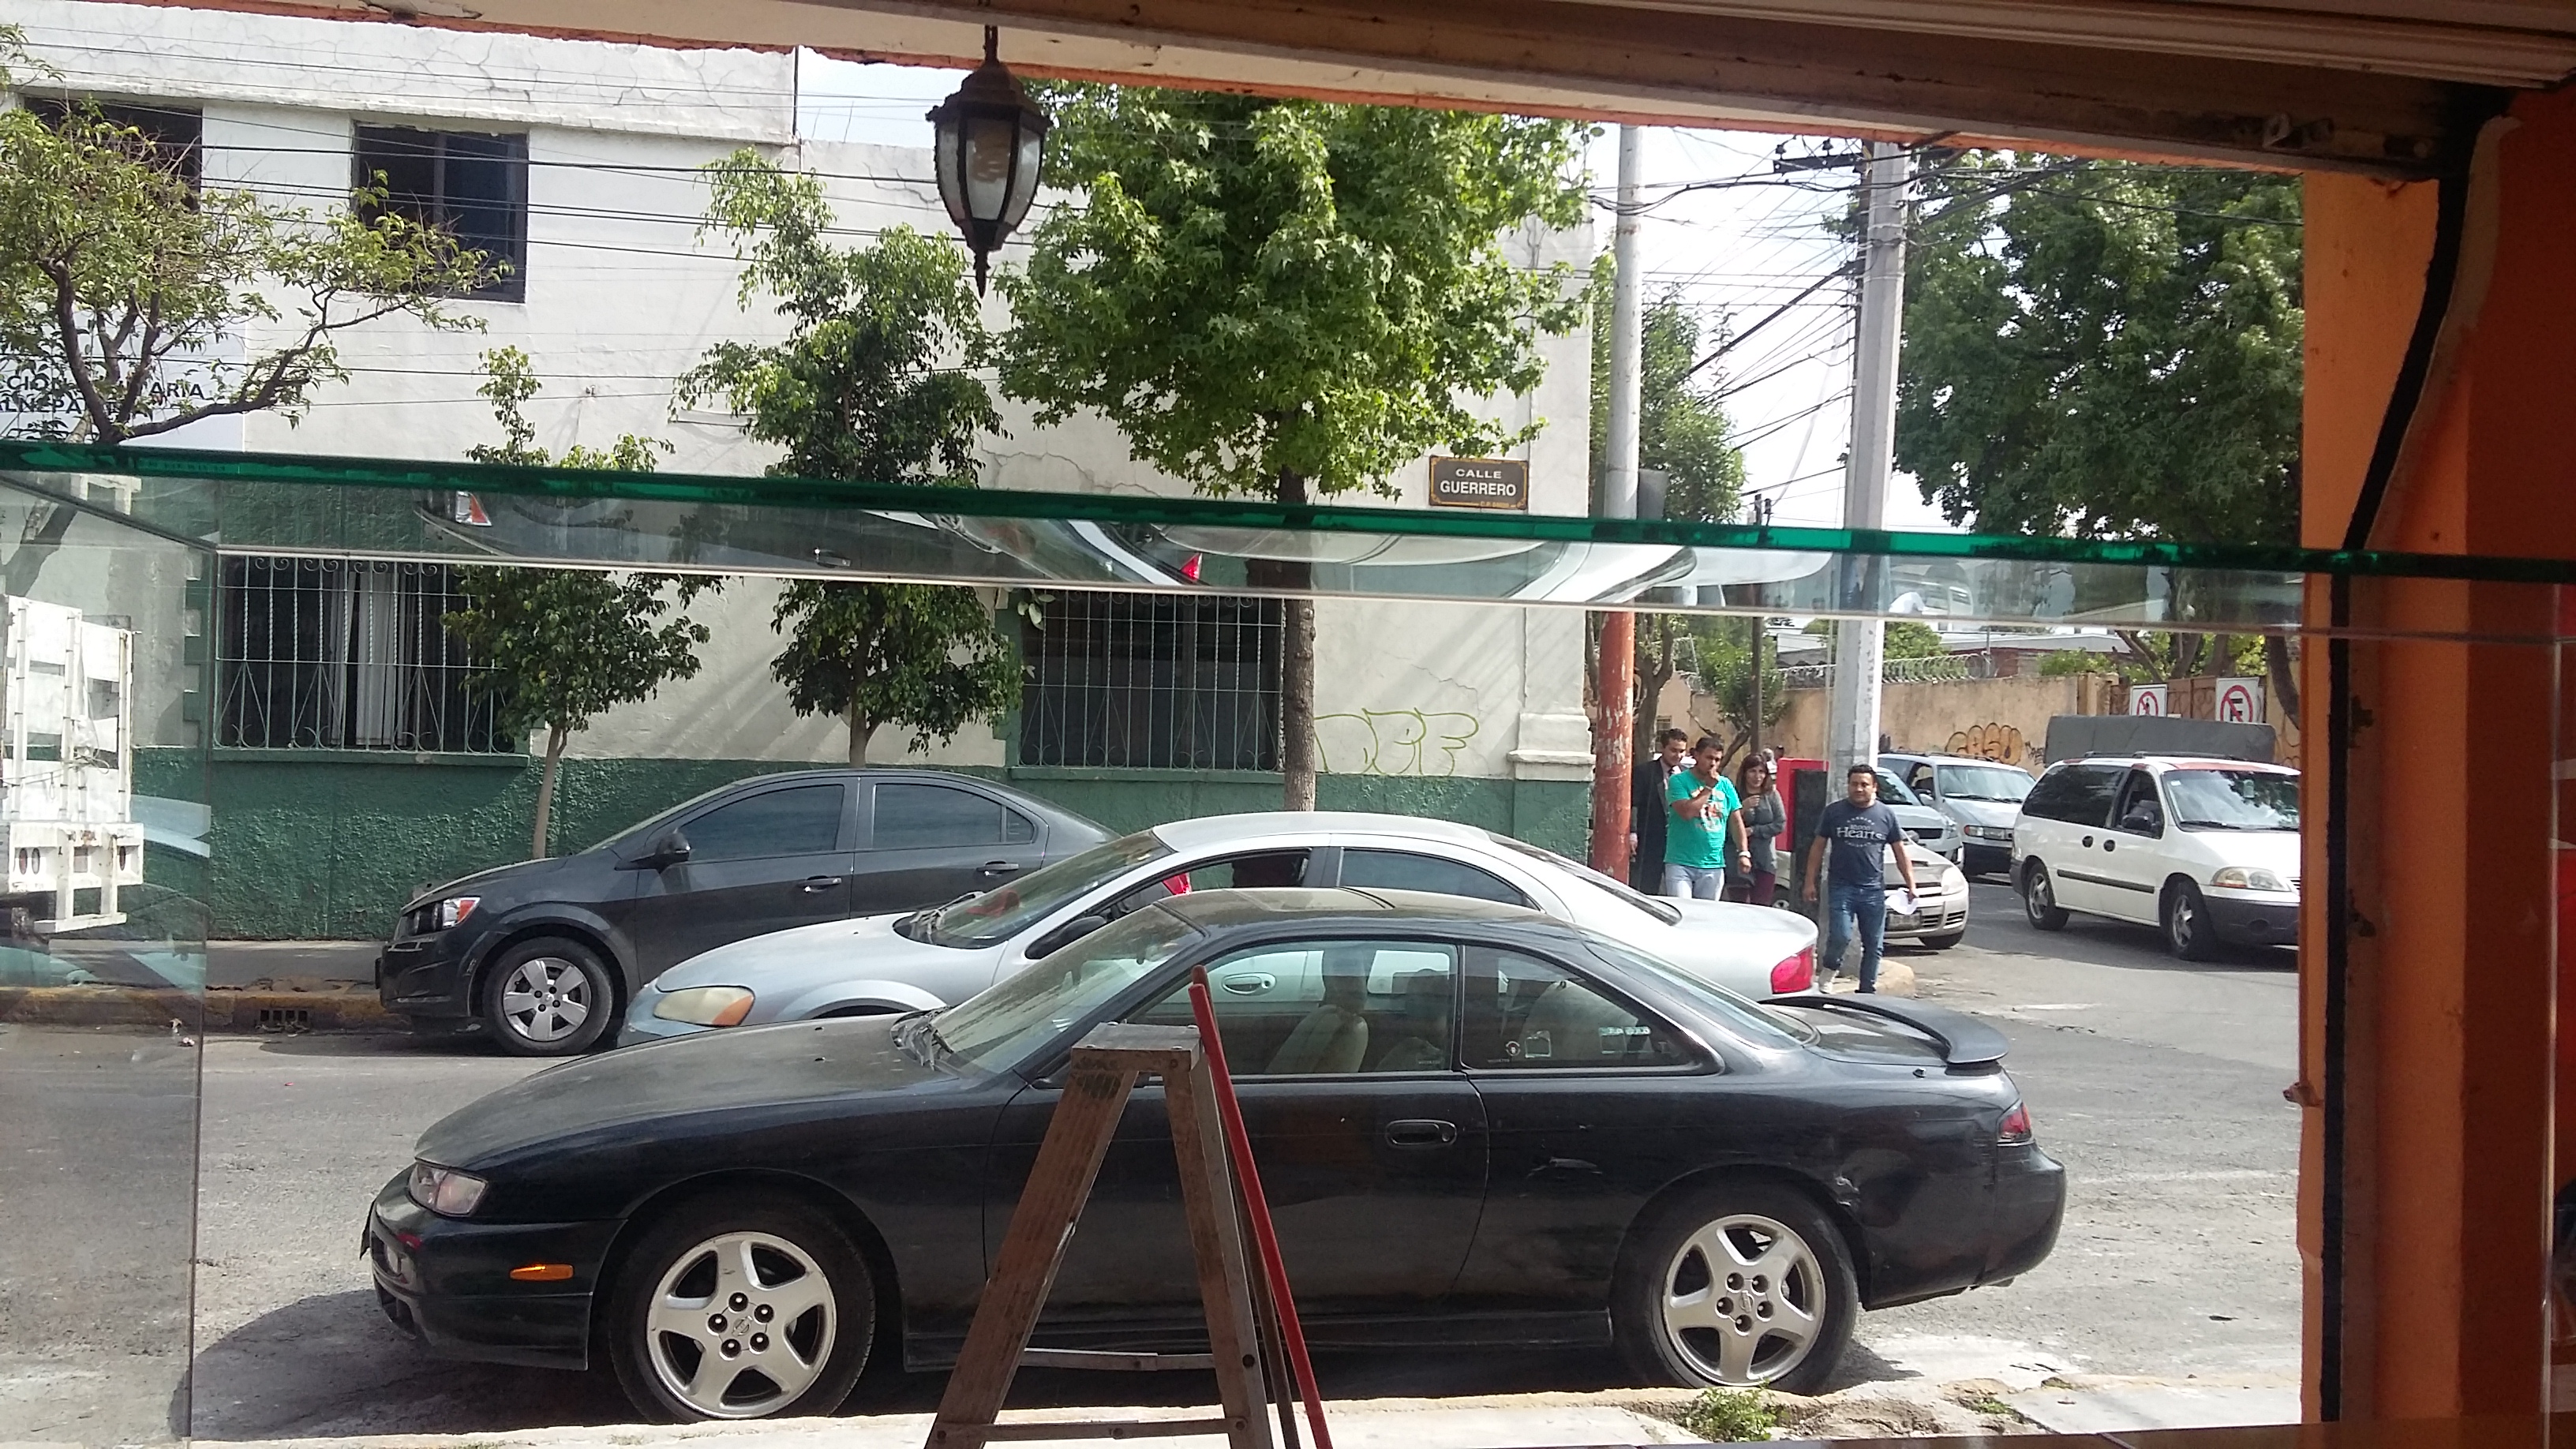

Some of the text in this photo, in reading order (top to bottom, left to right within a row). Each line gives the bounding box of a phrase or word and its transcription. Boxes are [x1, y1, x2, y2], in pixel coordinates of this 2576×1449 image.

[1455, 468, 1502, 479] CALLE
[1440, 480, 1517, 496] GUERRERO
[1836, 826, 1887, 841] Hearts
